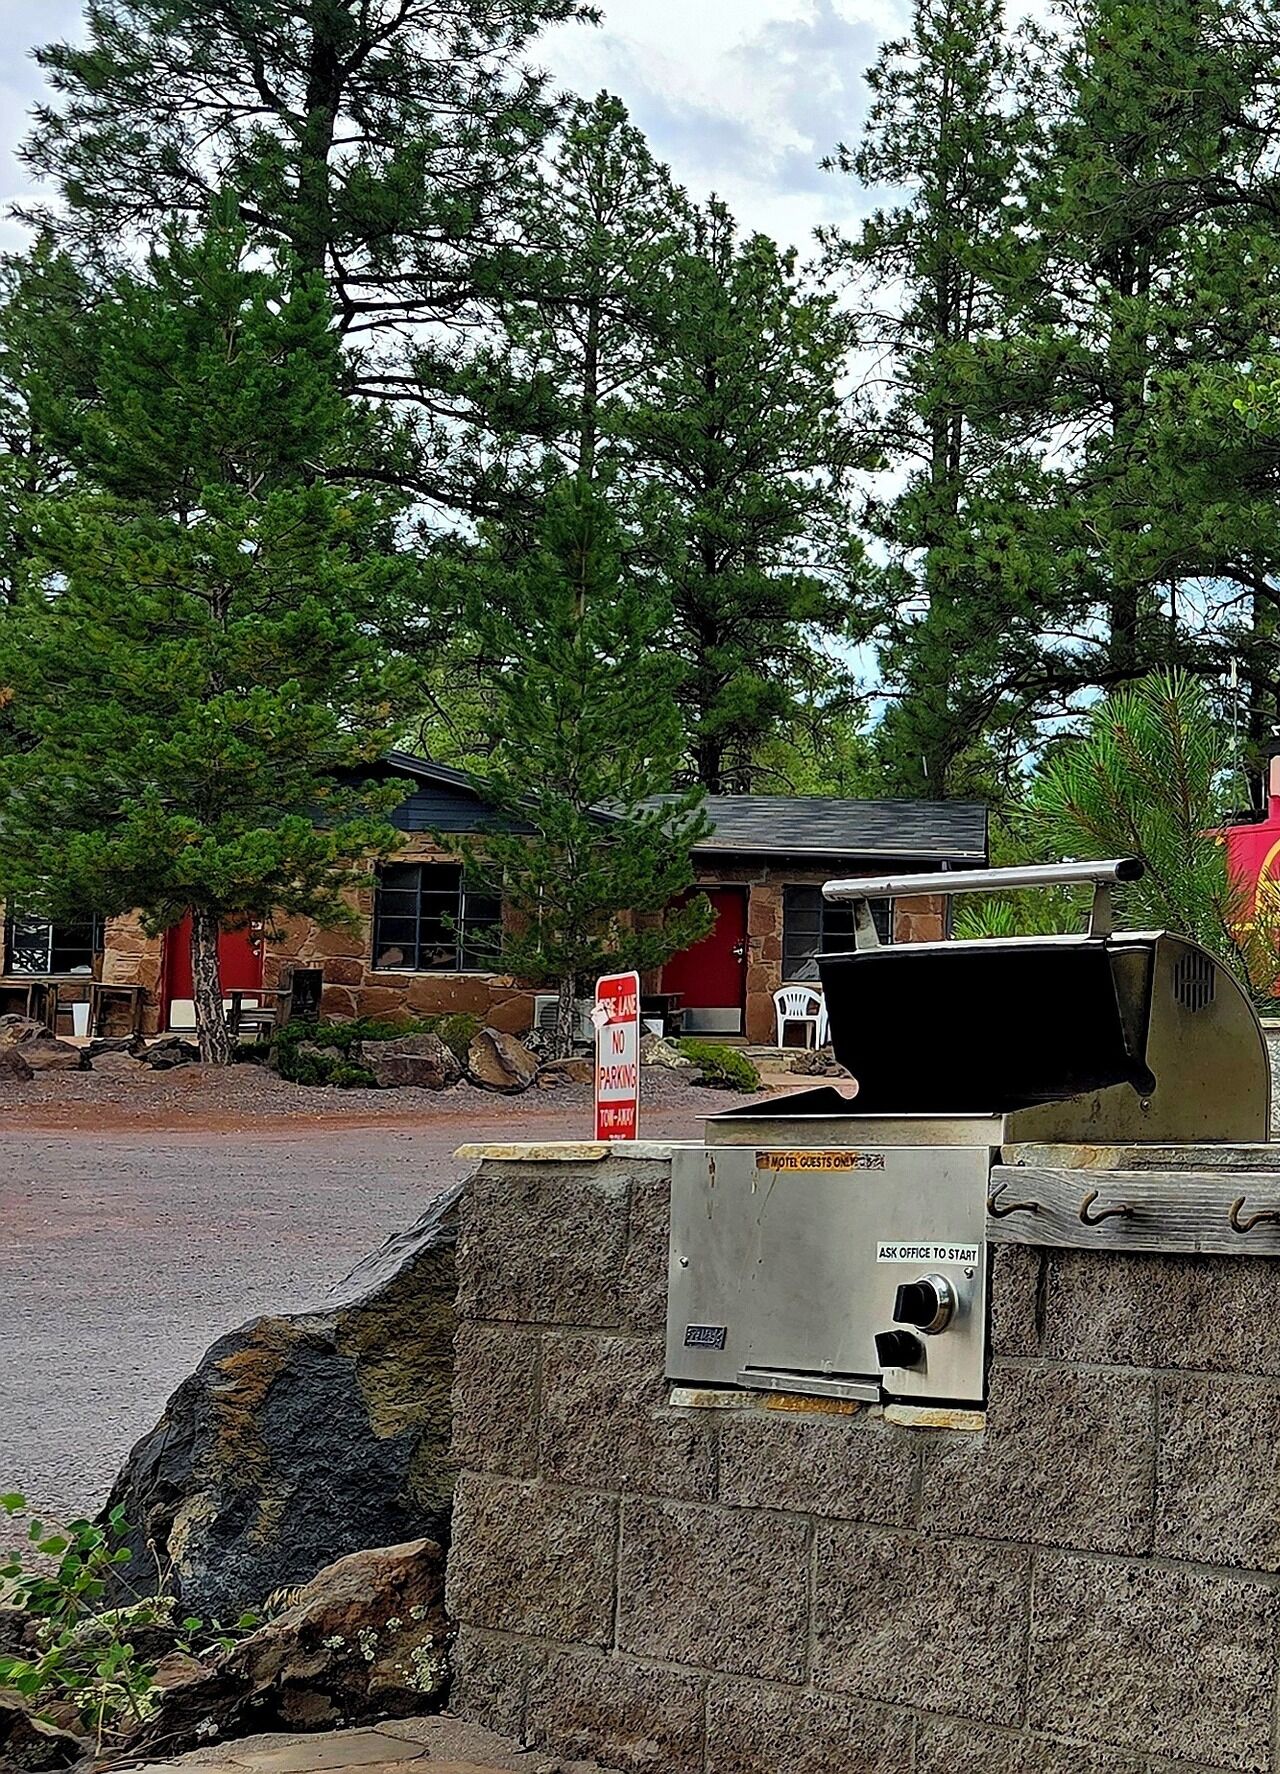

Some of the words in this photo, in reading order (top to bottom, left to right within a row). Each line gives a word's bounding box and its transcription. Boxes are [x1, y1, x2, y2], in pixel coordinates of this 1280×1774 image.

[612, 1030, 625, 1054] NO
[600, 1064, 636, 1090] PARKING
[600, 1108, 635, 1128] TOW-AWAY
[770, 1156, 798, 1168] MOTEL
[800, 1156, 831, 1168] GUESTS
[880, 1247, 898, 1258] ASK
[900, 1247, 930, 1258] OFFICE
[934, 1247, 946, 1259] TO
[948, 1248, 977, 1260] START
